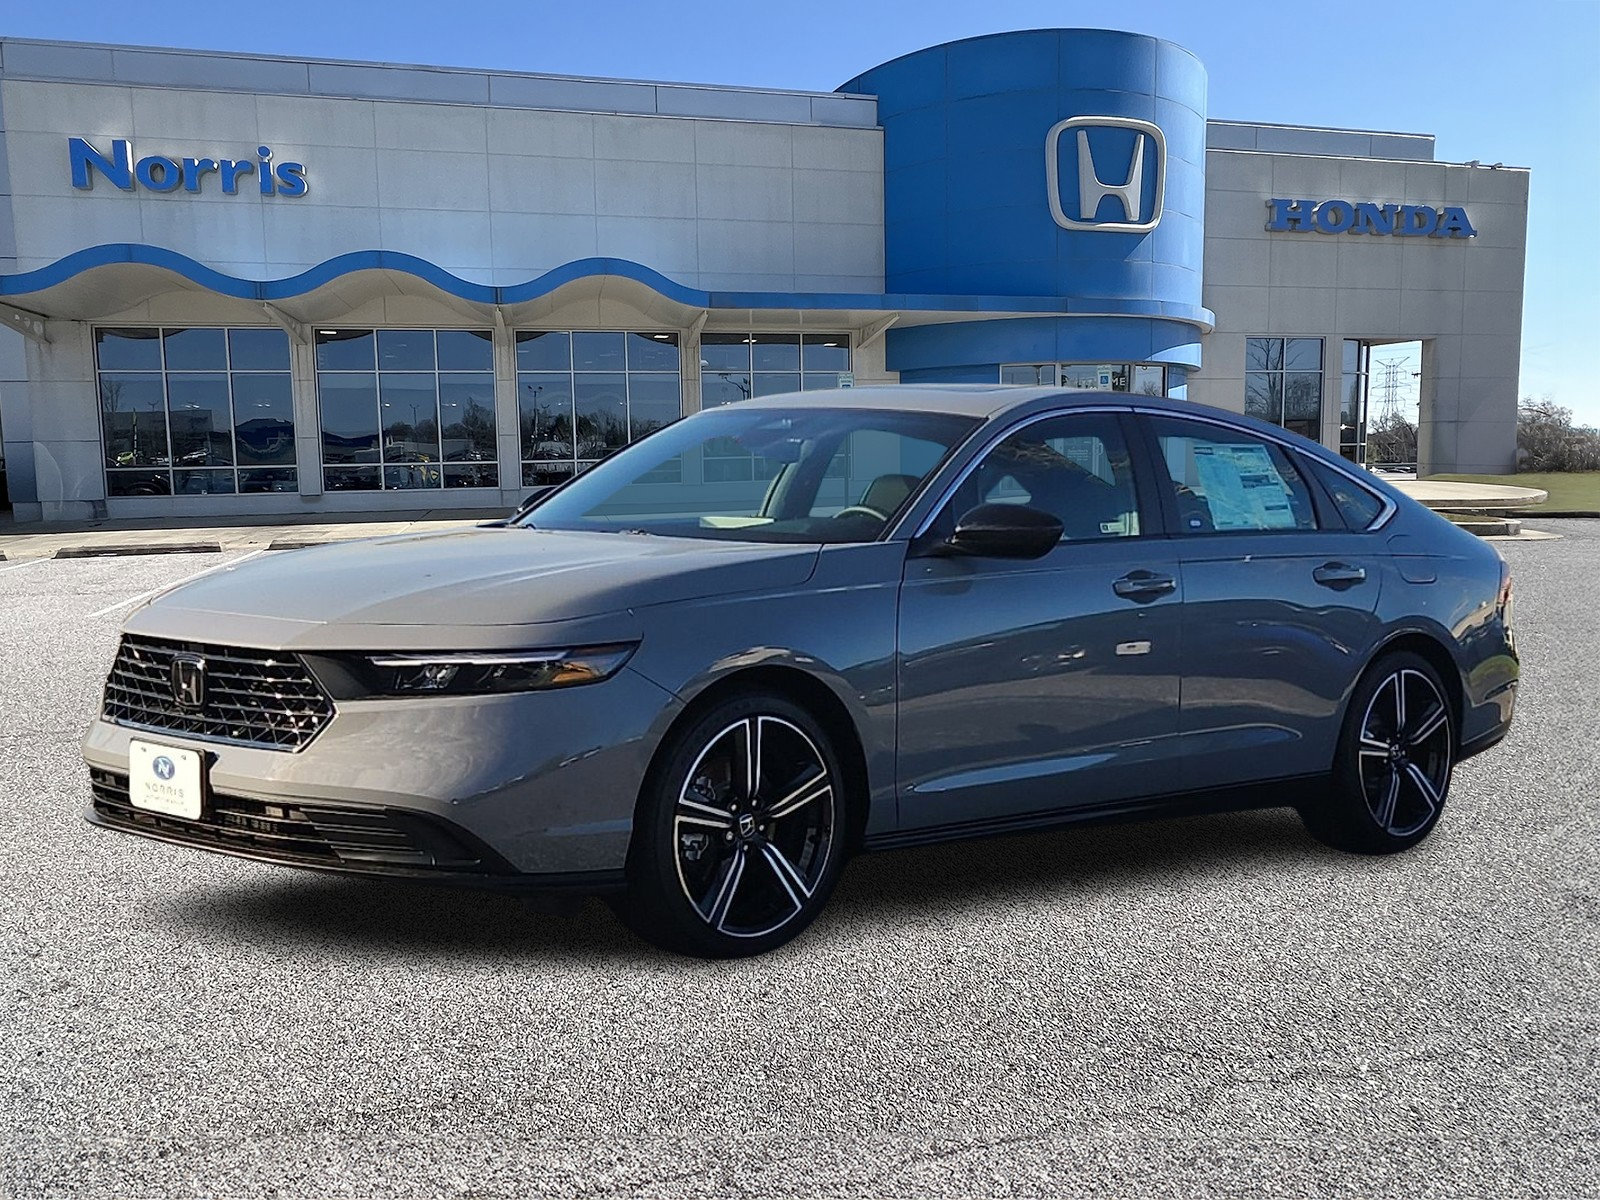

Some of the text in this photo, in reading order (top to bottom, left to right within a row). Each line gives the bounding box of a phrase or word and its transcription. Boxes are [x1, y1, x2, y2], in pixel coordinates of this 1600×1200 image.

[68, 137, 308, 197] Norris
[1265, 198, 1478, 239] HONDA
[145, 781, 185, 799] NORRIS
